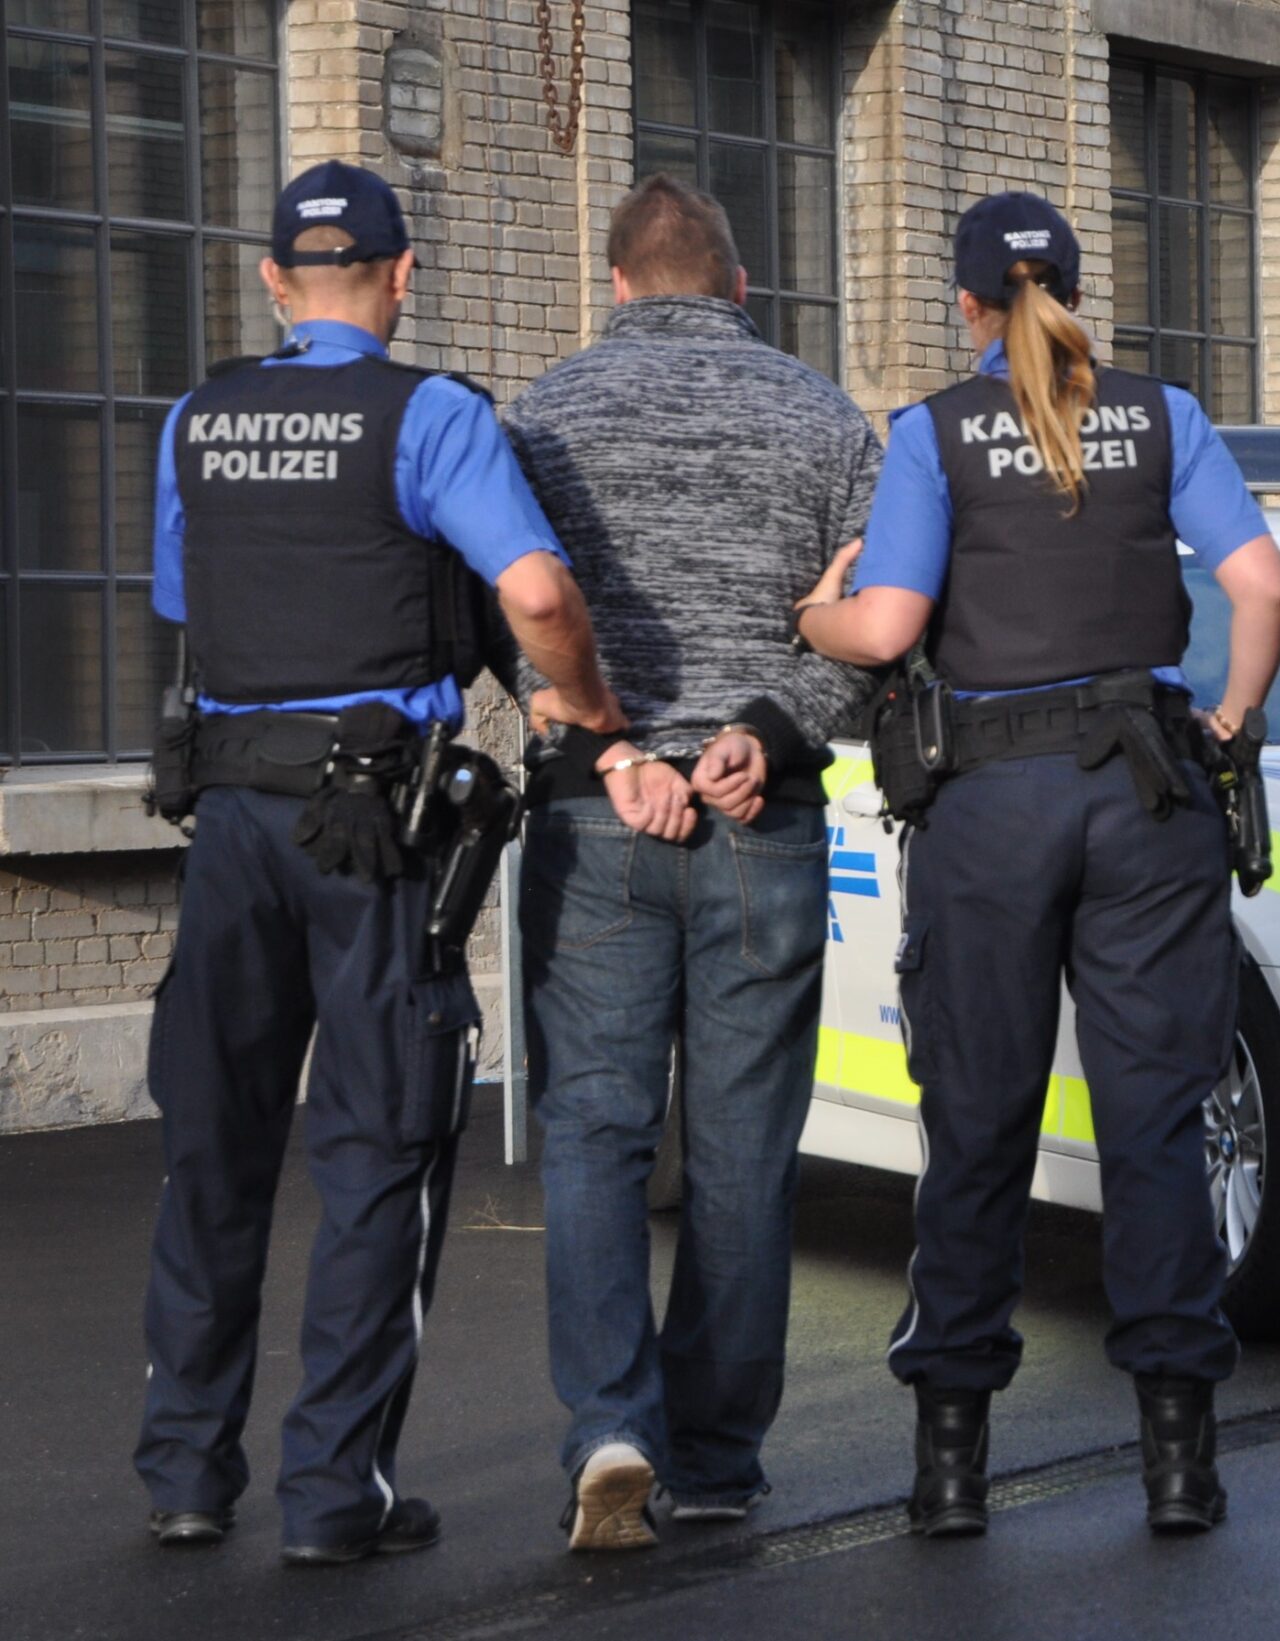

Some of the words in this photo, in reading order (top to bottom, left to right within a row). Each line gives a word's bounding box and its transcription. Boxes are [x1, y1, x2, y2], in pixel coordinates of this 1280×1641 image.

[188, 412, 364, 442] KANTONS
[960, 405, 1151, 443] KAONS
[203, 450, 338, 480] POLIZEI
[988, 439, 1138, 478] POZEI
